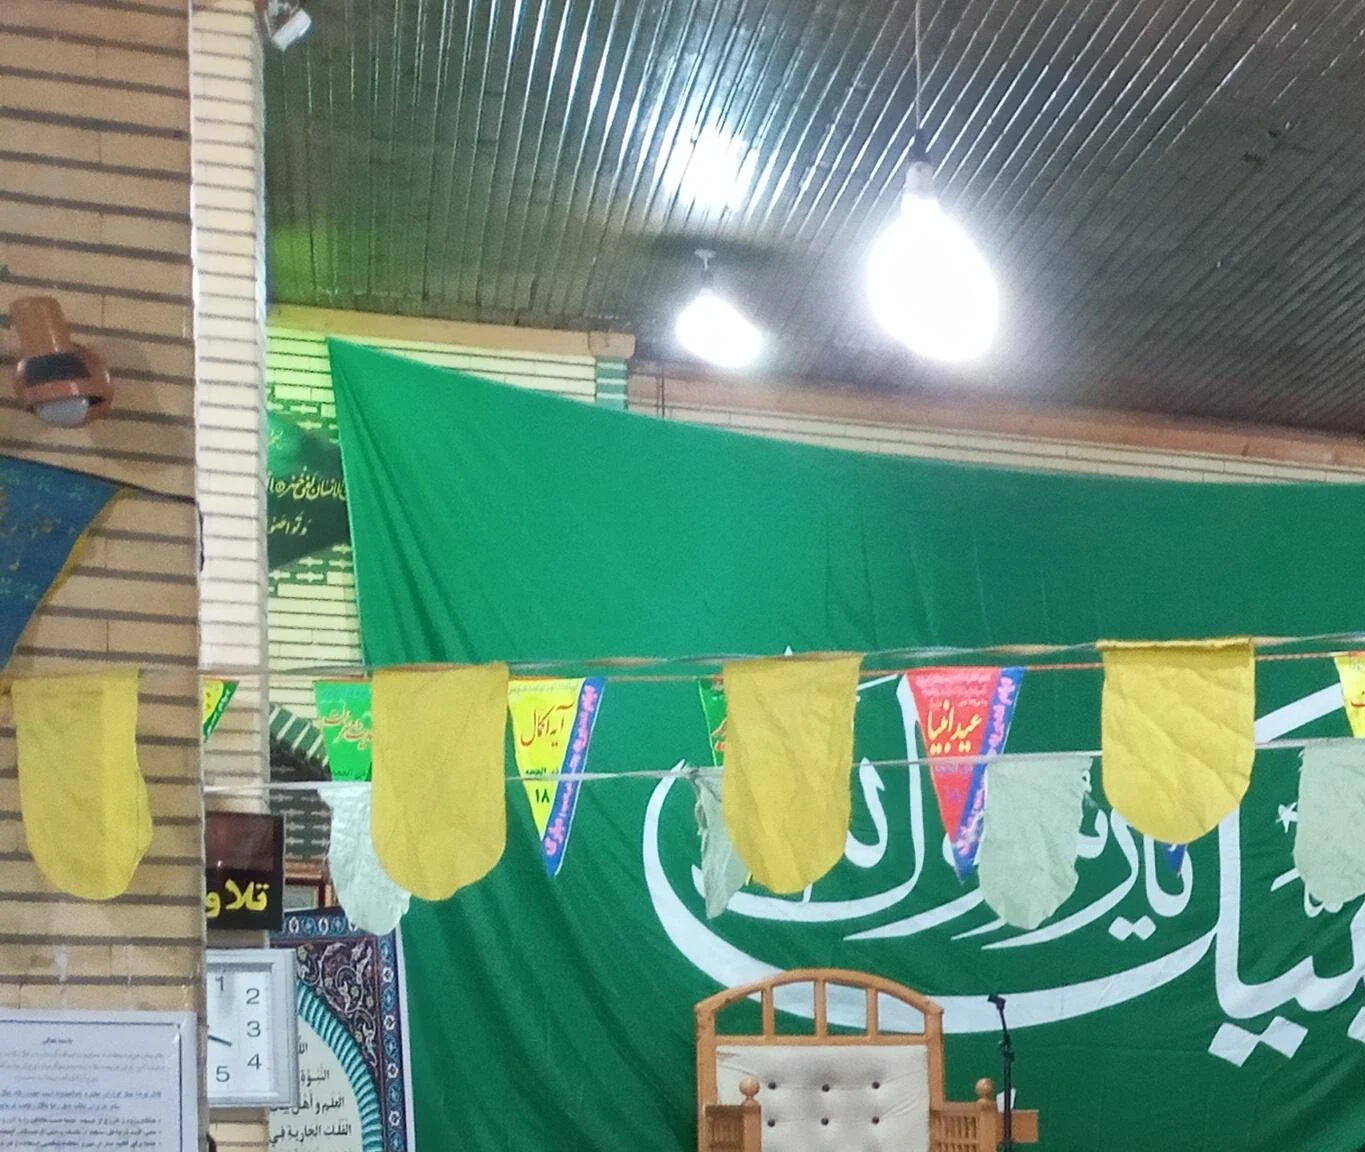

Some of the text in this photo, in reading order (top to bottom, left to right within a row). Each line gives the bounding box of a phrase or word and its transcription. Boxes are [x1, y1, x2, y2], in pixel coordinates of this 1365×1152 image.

[951, 713, 983, 752] عید
[206, 878, 270, 918] تلاو
[215, 975, 225, 992] 1
[246, 988, 260, 1005] 2
[246, 1021, 261, 1038] 3
[247, 1054, 262, 1070] 4
[216, 1066, 230, 1083] 5
